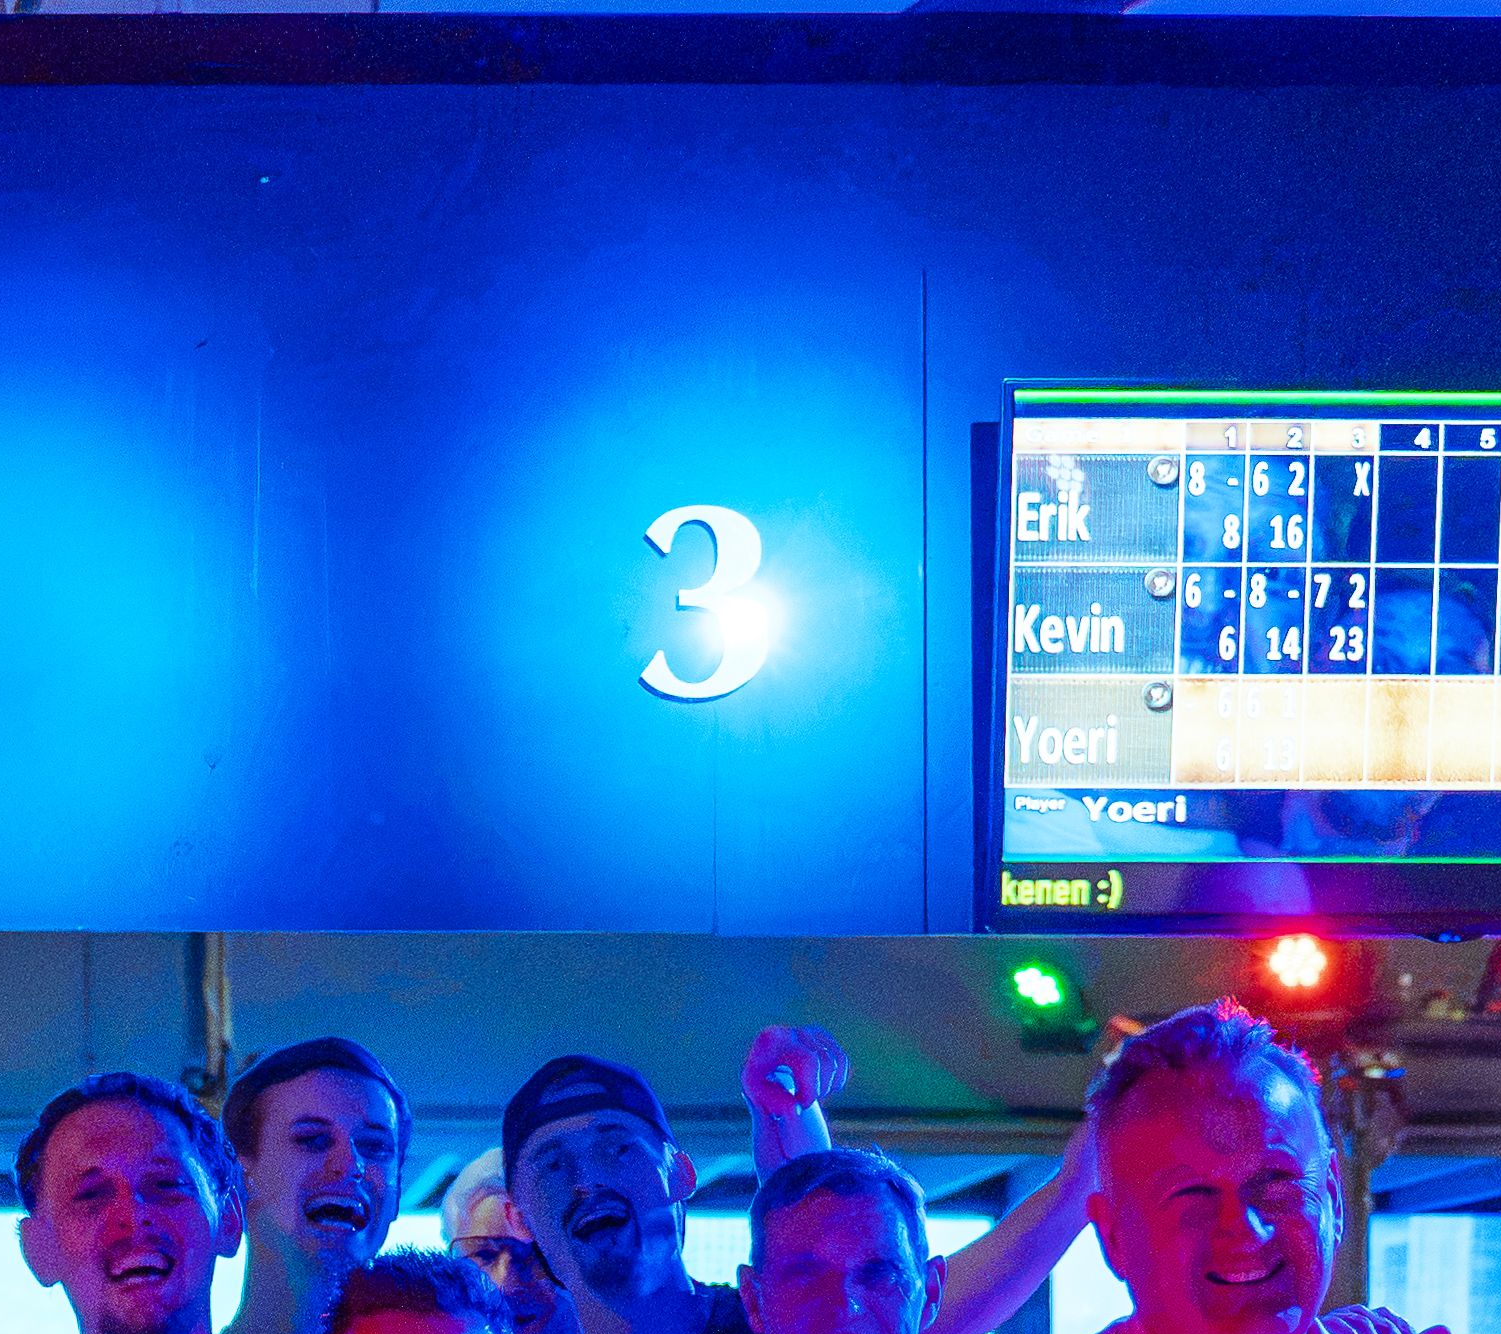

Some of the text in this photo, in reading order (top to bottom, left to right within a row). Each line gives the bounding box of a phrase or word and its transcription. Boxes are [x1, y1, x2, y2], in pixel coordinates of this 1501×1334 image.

[1224, 426, 1237, 448] 1
[1286, 427, 1303, 448] 2
[1351, 427, 1366, 448] 3
[1413, 429, 1431, 448] 4
[1479, 429, 1496, 449] 5
[1188, 461, 1371, 496] 8 6 2 X
[1017, 490, 1092, 542] Erik
[1222, 514, 1304, 549] 8 16
[639, 503, 770, 702] 3
[1185, 573, 1366, 608] 6 8 7 2
[1014, 603, 1125, 653] Kevin
[1219, 626, 1364, 661] 6 14 23
[1012, 714, 1118, 765] Yoeri
[1015, 795, 1187, 823] Player Yoeri
[1001, 872, 1090, 905] kenen
